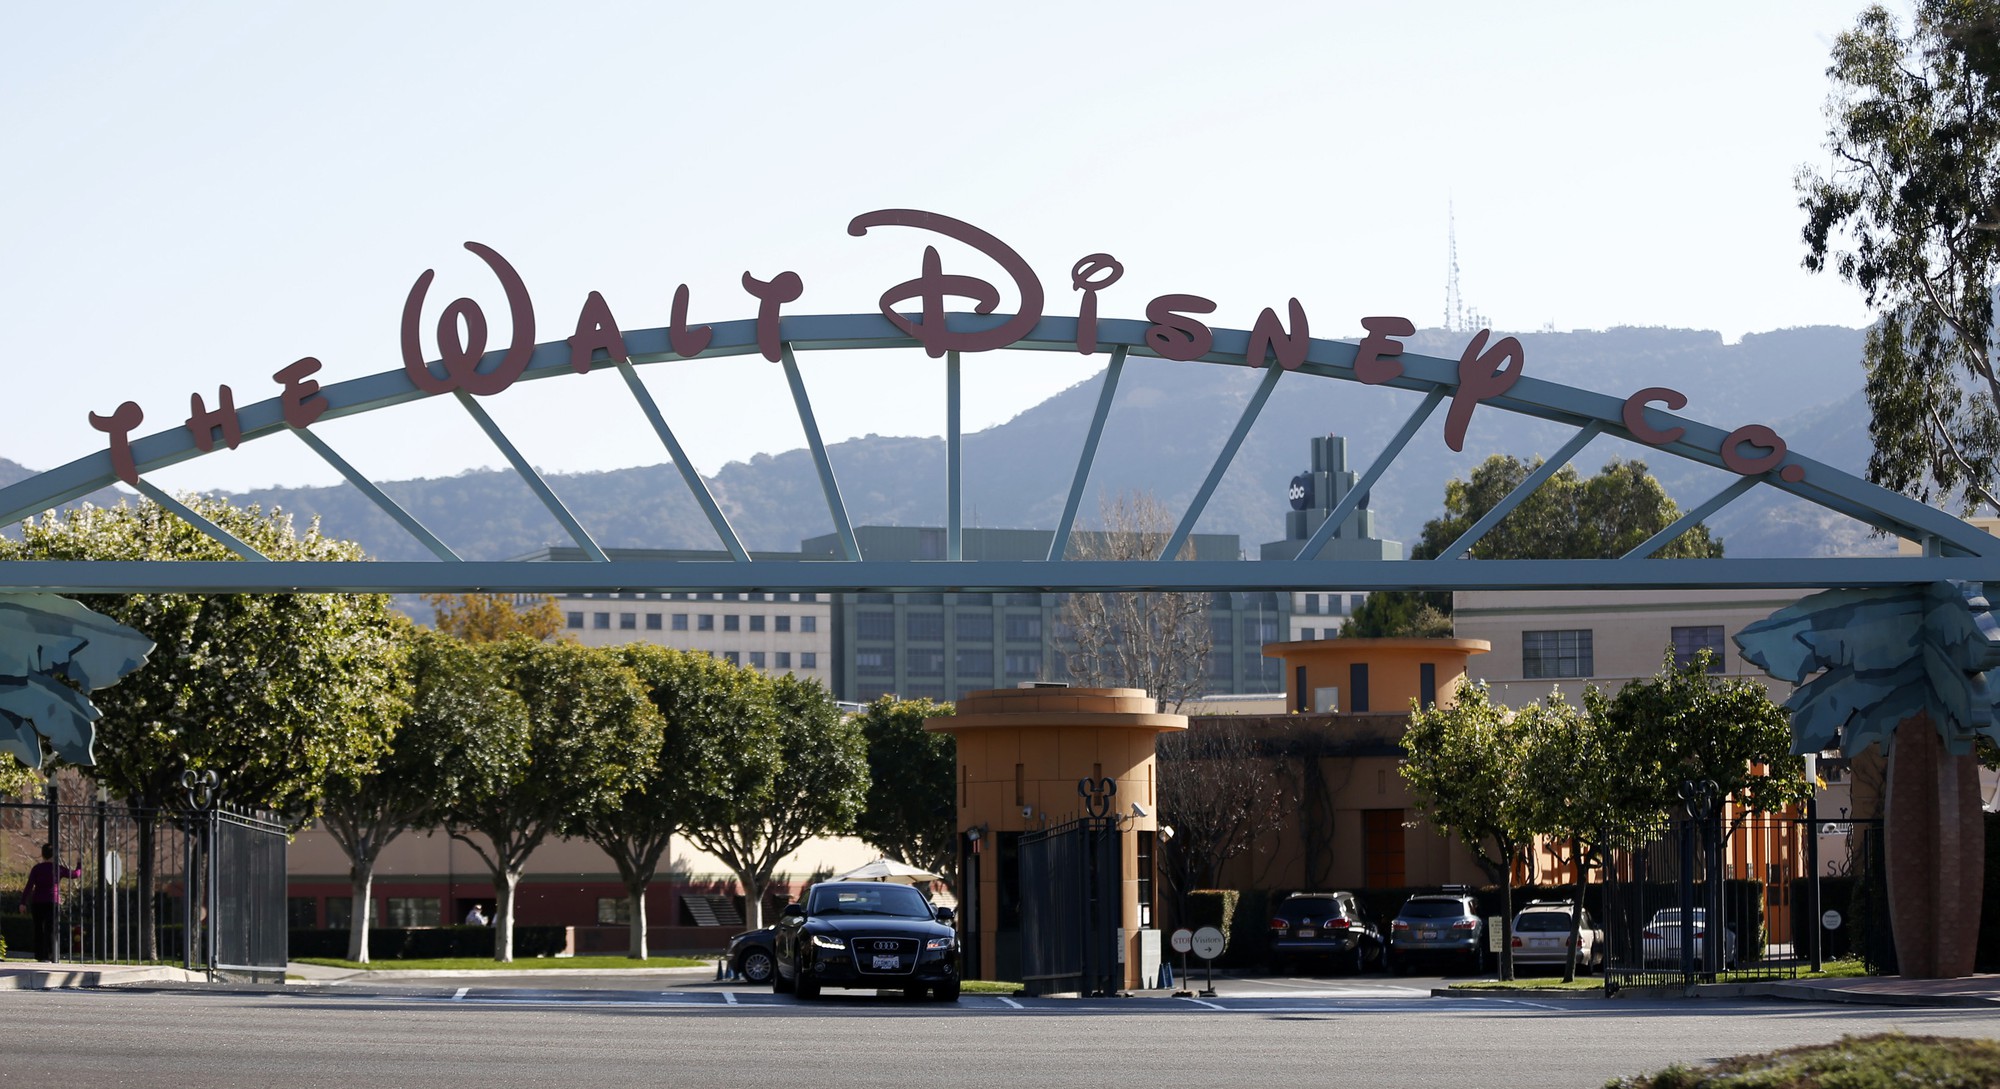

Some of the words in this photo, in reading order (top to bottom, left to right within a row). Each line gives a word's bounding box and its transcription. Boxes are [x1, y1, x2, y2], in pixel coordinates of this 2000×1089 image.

[88, 356, 329, 486] THE
[400, 241, 804, 397] WALT
[847, 208, 1524, 453] DISNEY
[1289, 484, 1305, 500] abc
[1194, 936, 1221, 944] Visitors
